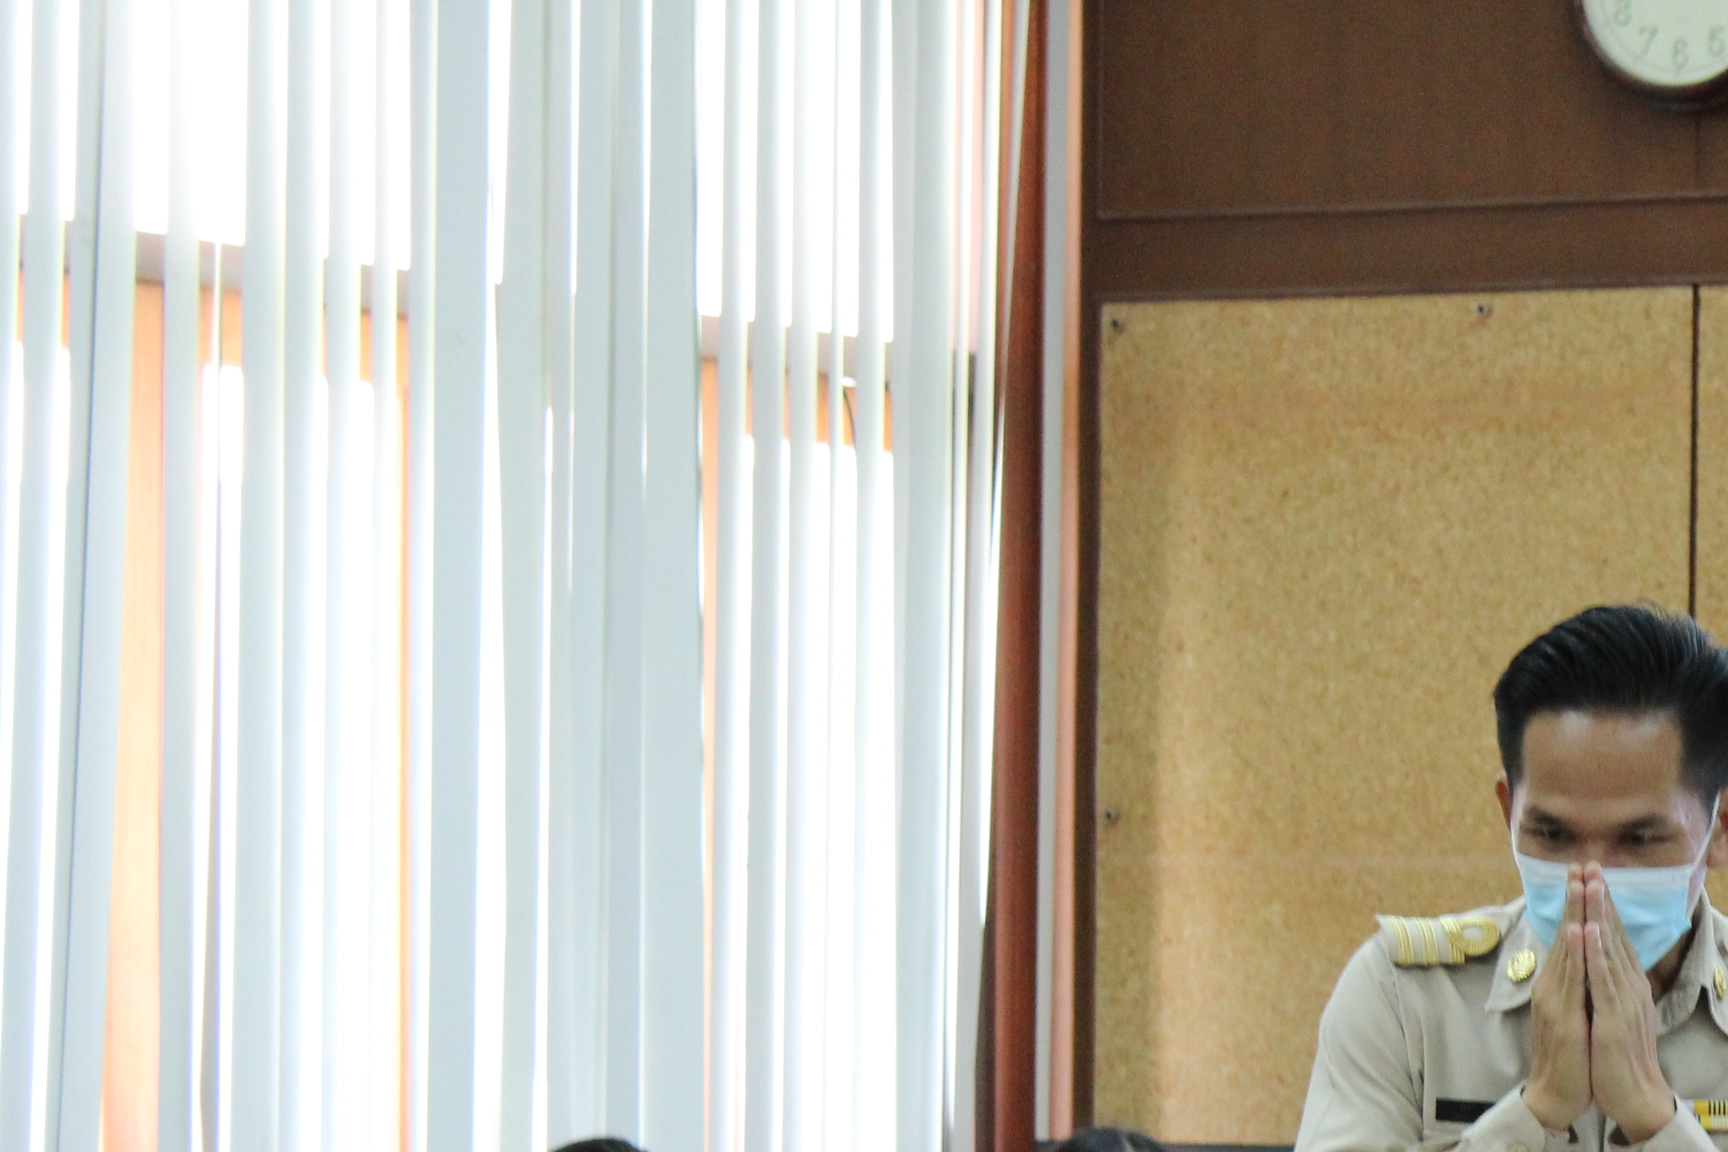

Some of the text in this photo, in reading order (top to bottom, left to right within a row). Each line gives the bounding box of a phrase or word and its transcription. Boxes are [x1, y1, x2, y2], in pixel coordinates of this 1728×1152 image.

[1638, 26, 1660, 58] 7
[1671, 37, 1690, 70] 6
[1707, 26, 1727, 57] 5
